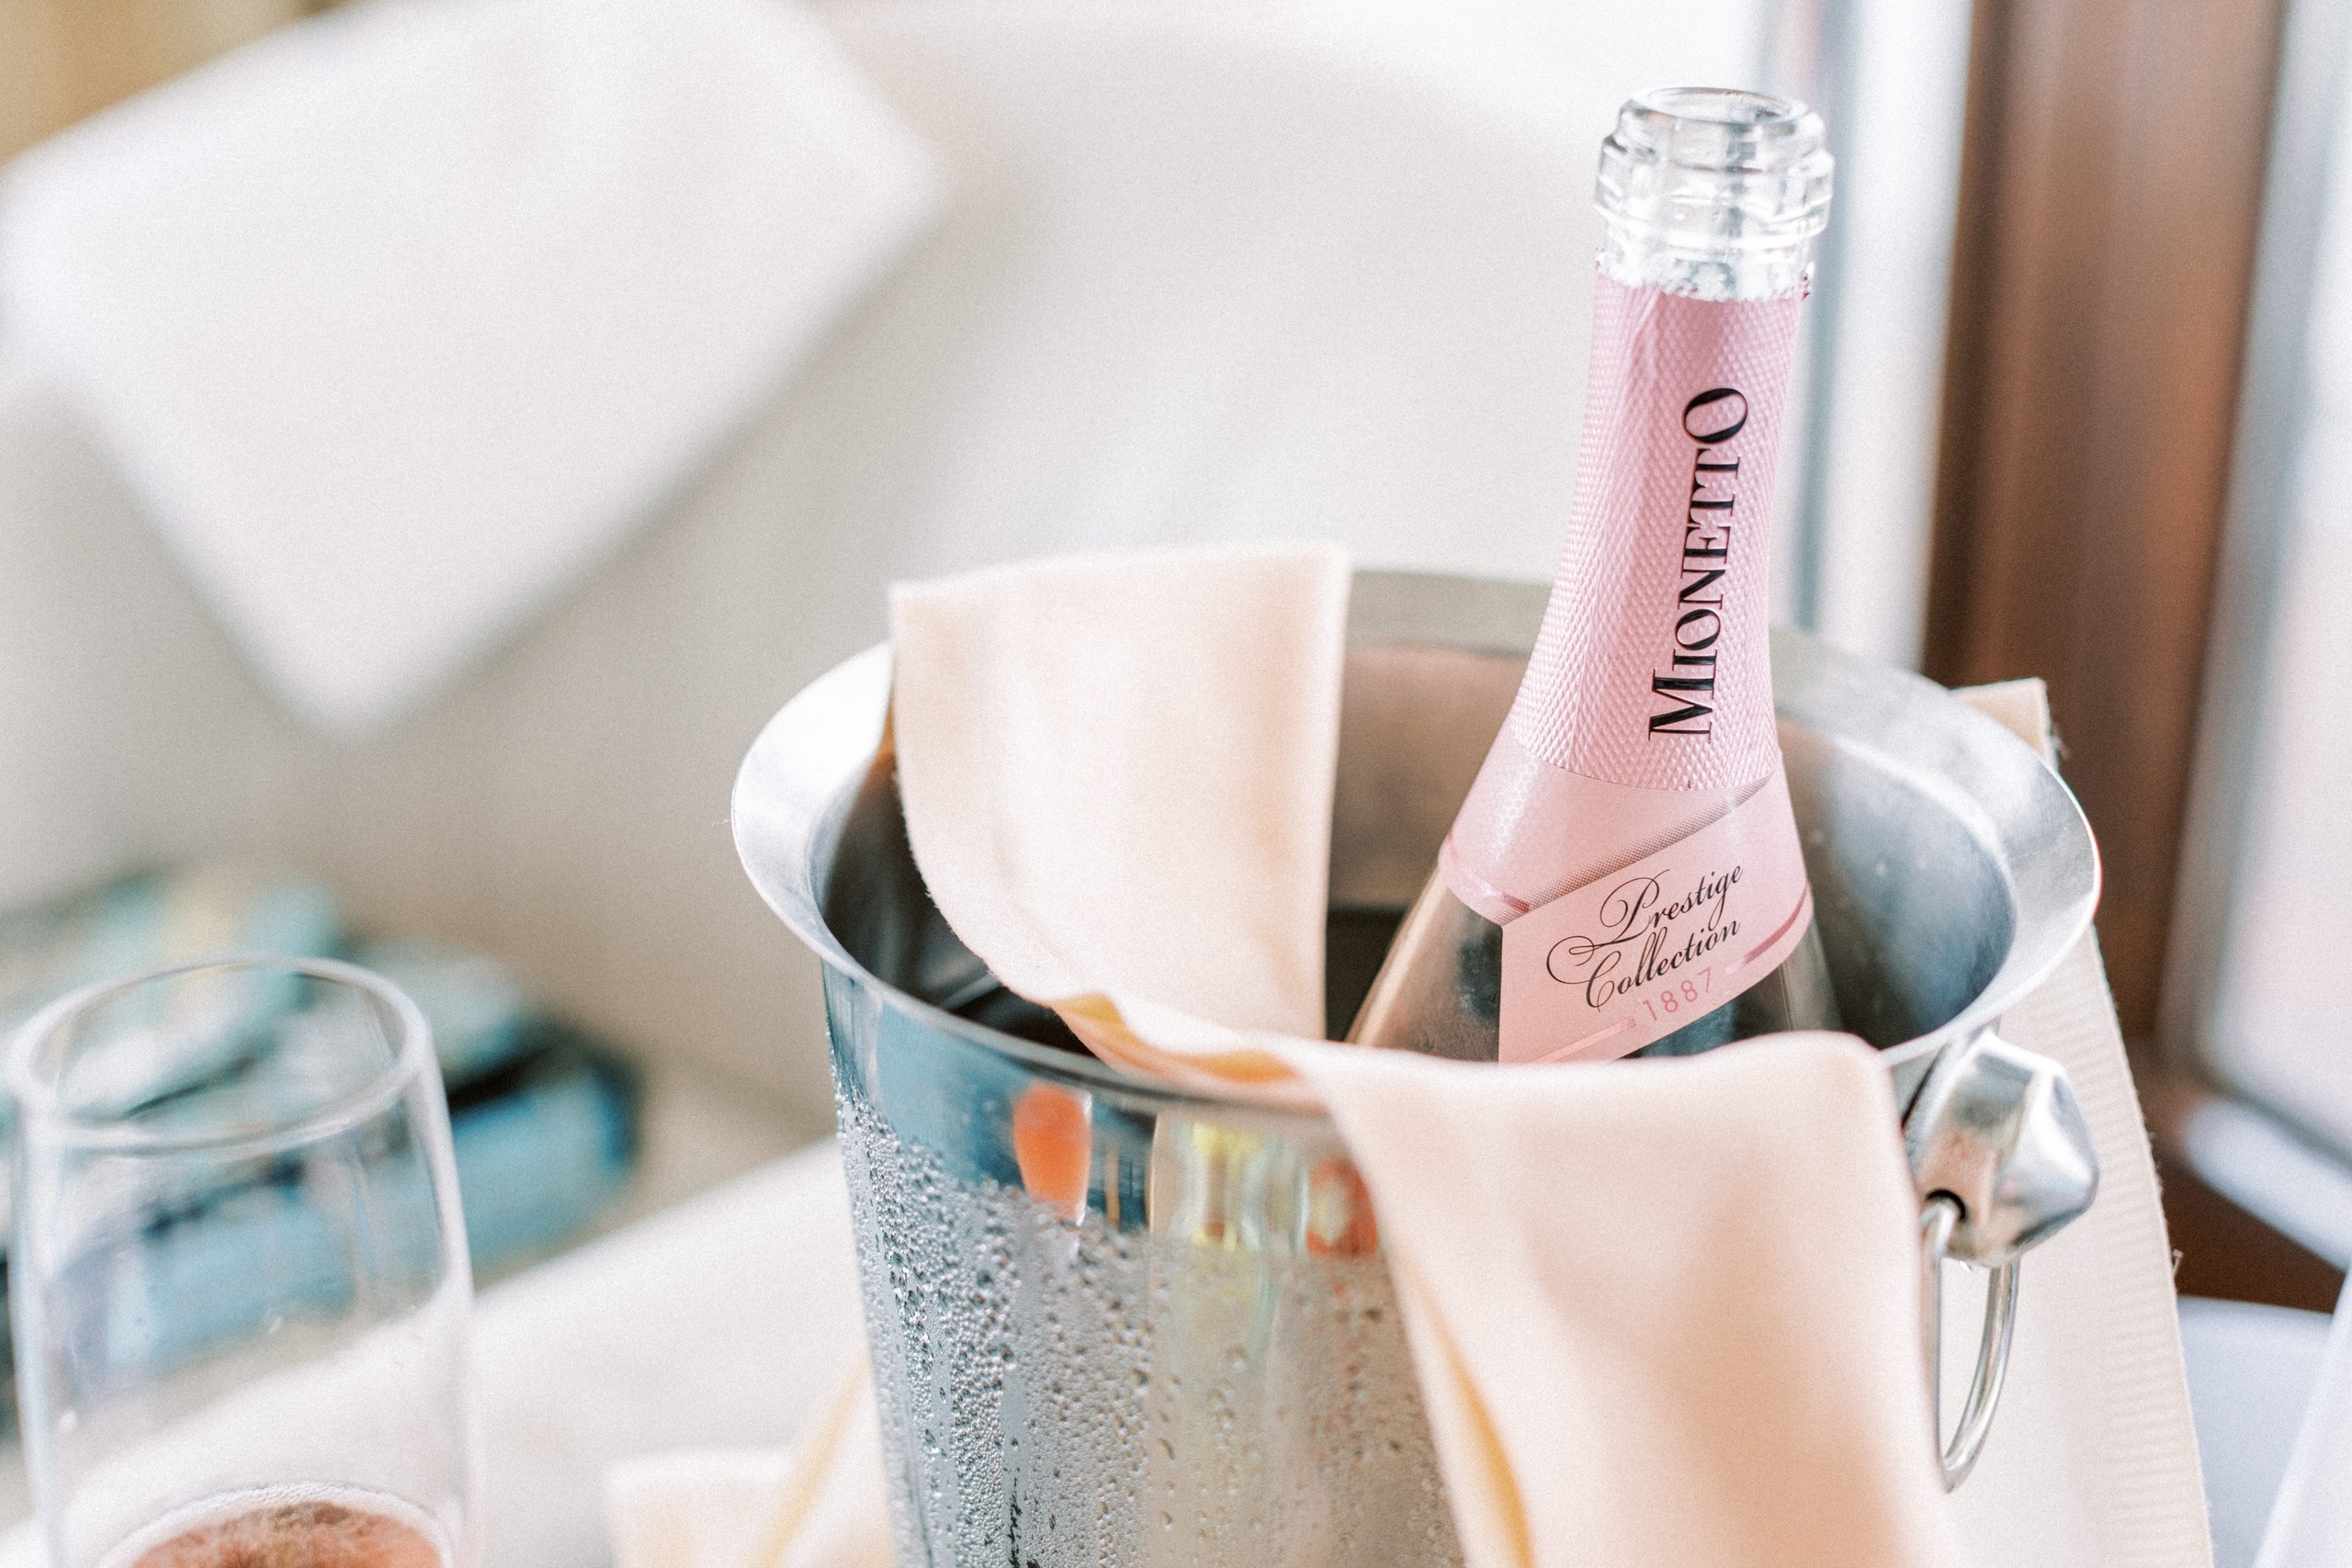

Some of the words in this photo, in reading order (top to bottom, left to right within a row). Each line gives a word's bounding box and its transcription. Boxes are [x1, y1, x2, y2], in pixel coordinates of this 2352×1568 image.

[1568, 864, 1743, 955] Prestige
[1545, 919, 1741, 1013] Collection
[1642, 965, 1713, 1021] 1887
